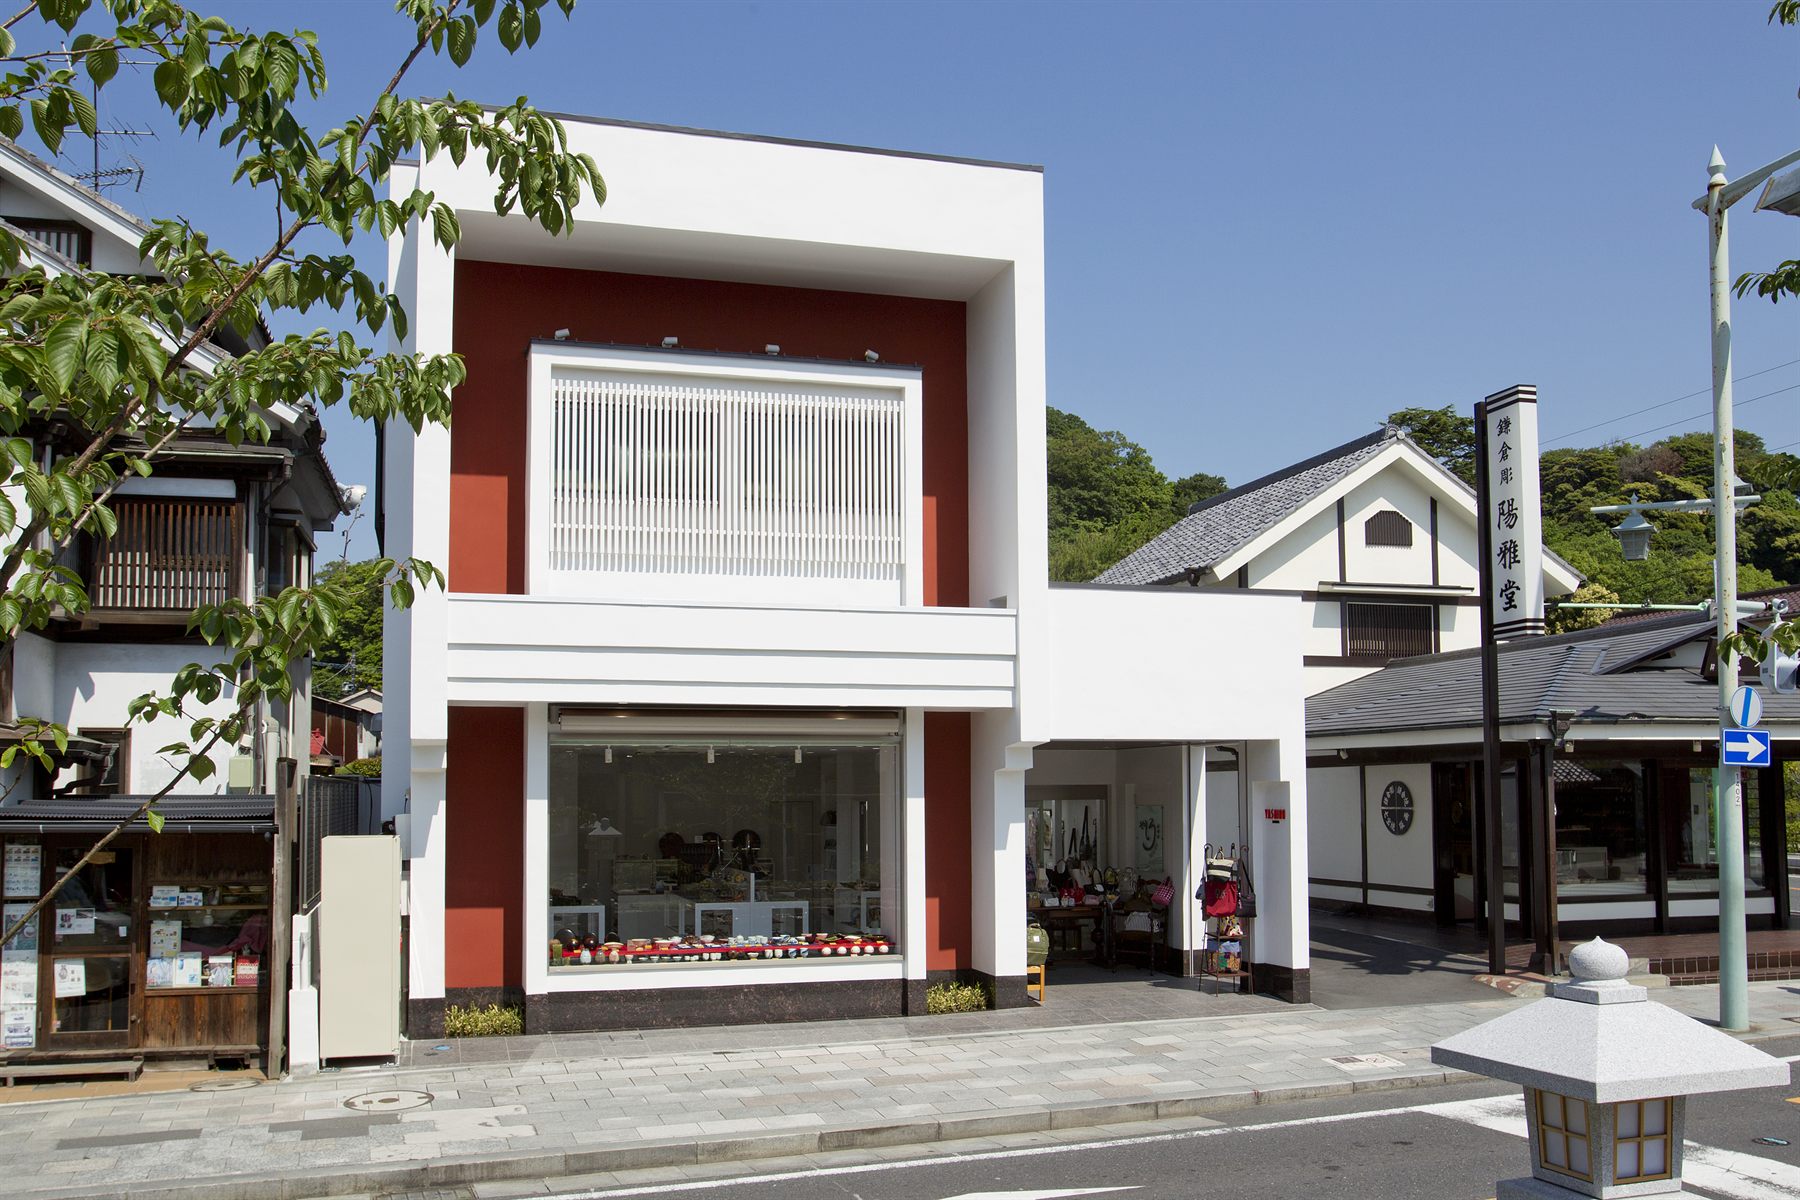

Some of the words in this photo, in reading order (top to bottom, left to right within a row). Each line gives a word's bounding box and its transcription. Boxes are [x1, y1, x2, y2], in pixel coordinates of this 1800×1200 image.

[1496, 416, 1513, 486] 鎌倉彫
[1497, 498, 1521, 612] 陽雅堂
